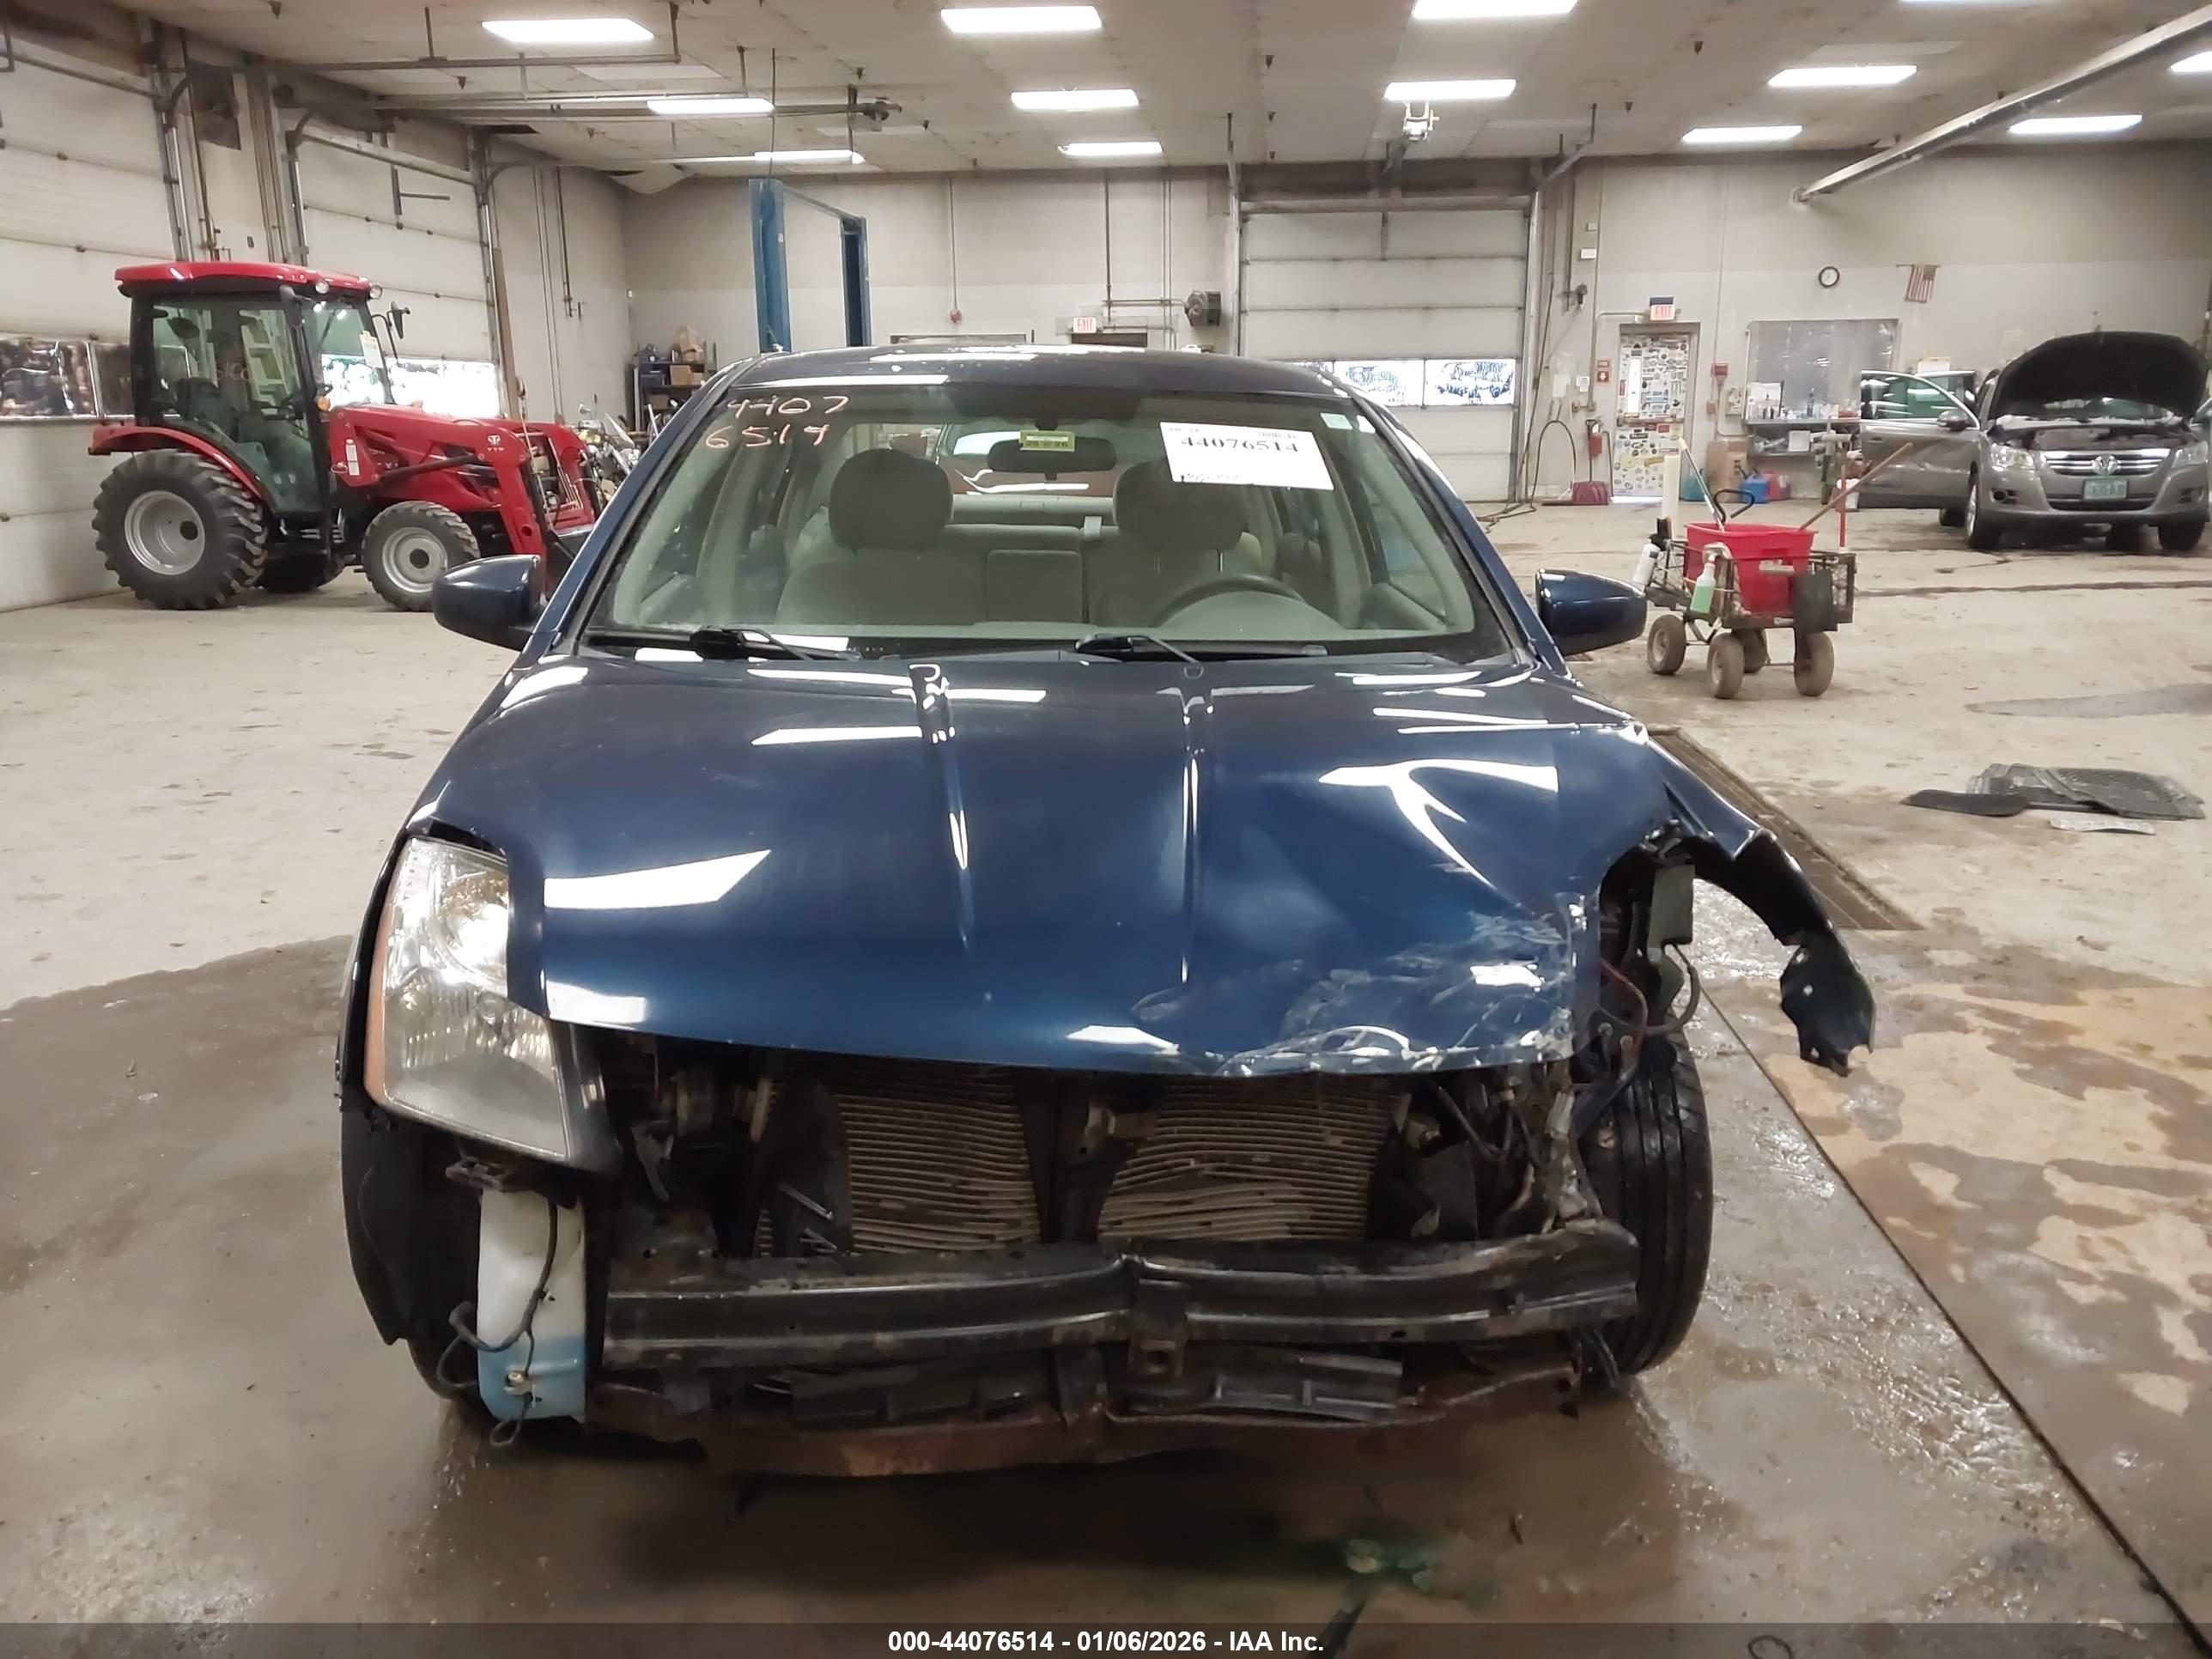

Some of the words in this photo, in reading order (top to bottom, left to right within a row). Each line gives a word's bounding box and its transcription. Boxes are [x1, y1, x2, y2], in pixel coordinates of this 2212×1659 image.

[1077, 318, 1093, 331] EXIT
[727, 395, 848, 418] 4407
[1181, 437, 1299, 452] 44076514
